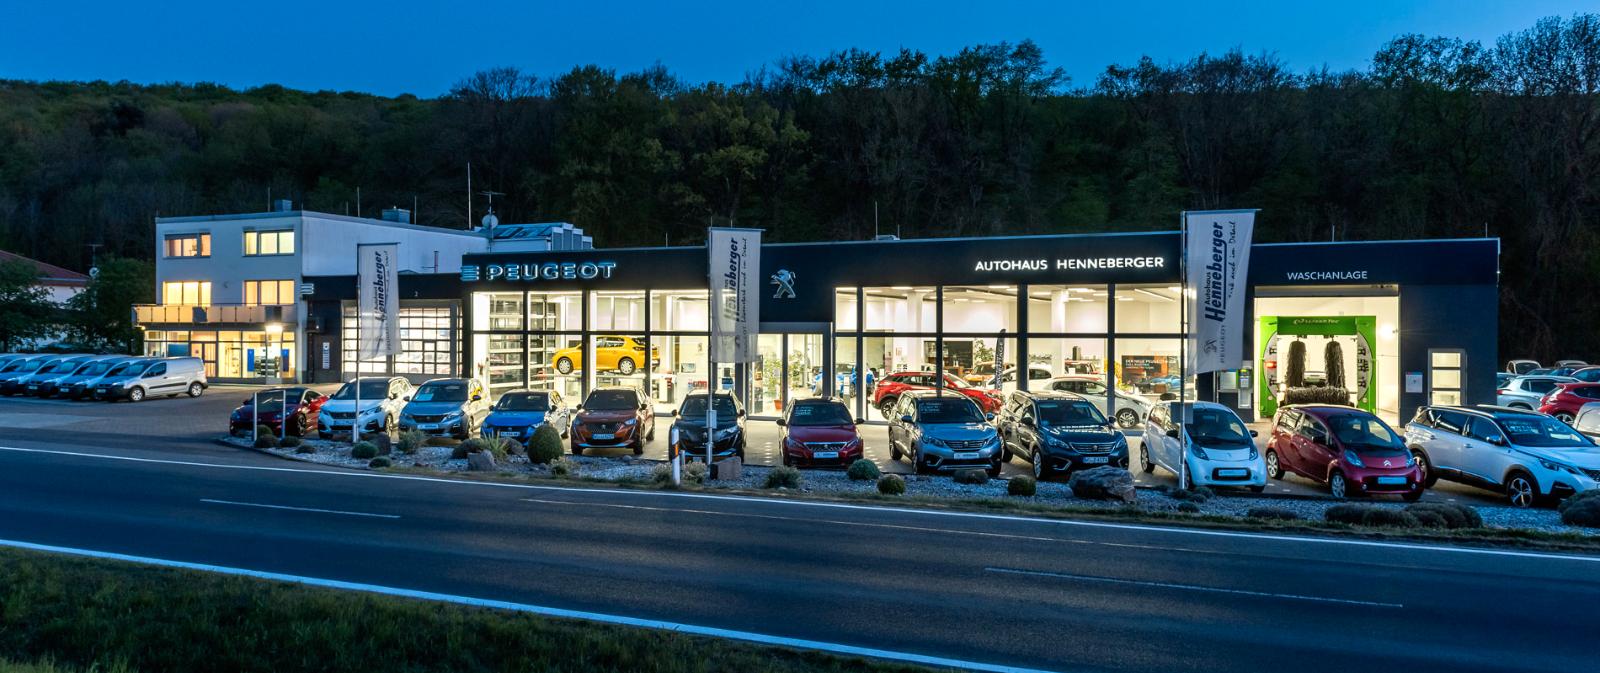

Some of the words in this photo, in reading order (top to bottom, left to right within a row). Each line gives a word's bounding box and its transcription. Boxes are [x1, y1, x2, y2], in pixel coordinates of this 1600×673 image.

[1227, 221, 1237, 244] Detail
[486, 262, 616, 281] PEUGEOT
[975, 259, 1048, 272] AUTOHAUS
[1057, 256, 1164, 270] HENNEBERGER
[1204, 221, 1227, 323] Henneberger
[1287, 270, 1368, 280] WASCHANLAGE
[1203, 271, 1212, 306] Autohaus
